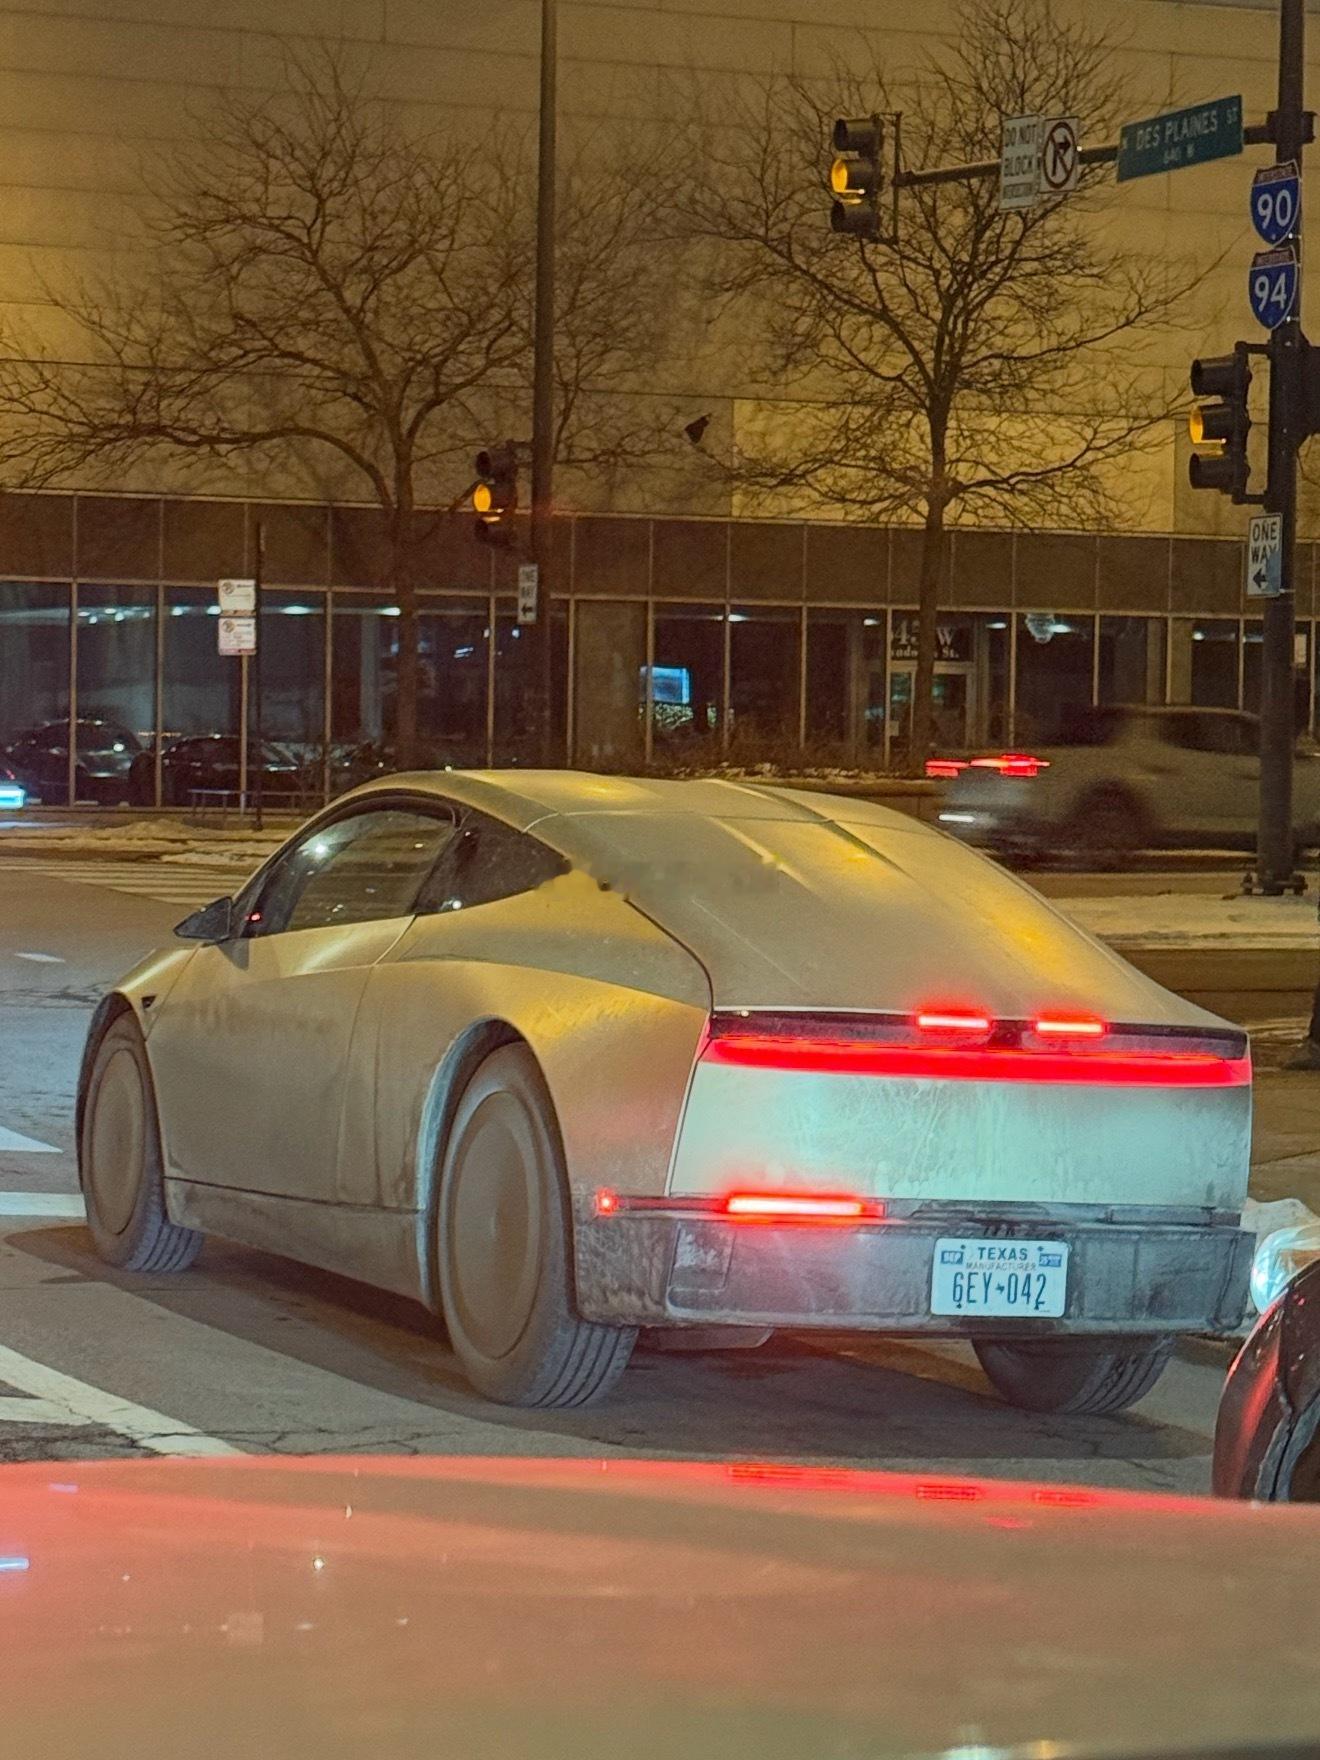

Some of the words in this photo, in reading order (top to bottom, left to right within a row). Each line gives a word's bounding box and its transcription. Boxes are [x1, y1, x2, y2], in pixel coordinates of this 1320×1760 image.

[1019, 124, 1037, 145] NOT
[1136, 124, 1160, 150] DES
[1164, 110, 1218, 143] PLAINES
[1226, 107, 1238, 124] ST
[1004, 154, 1034, 178] BLOCK
[1257, 189, 1292, 229] 90
[1254, 272, 1288, 312] 94
[1252, 521, 1278, 542] ONE
[1251, 544, 1278, 565] WAY
[977, 1246, 1028, 1261] TEXAS
[965, 1262, 1037, 1272] MANUFACTURER
